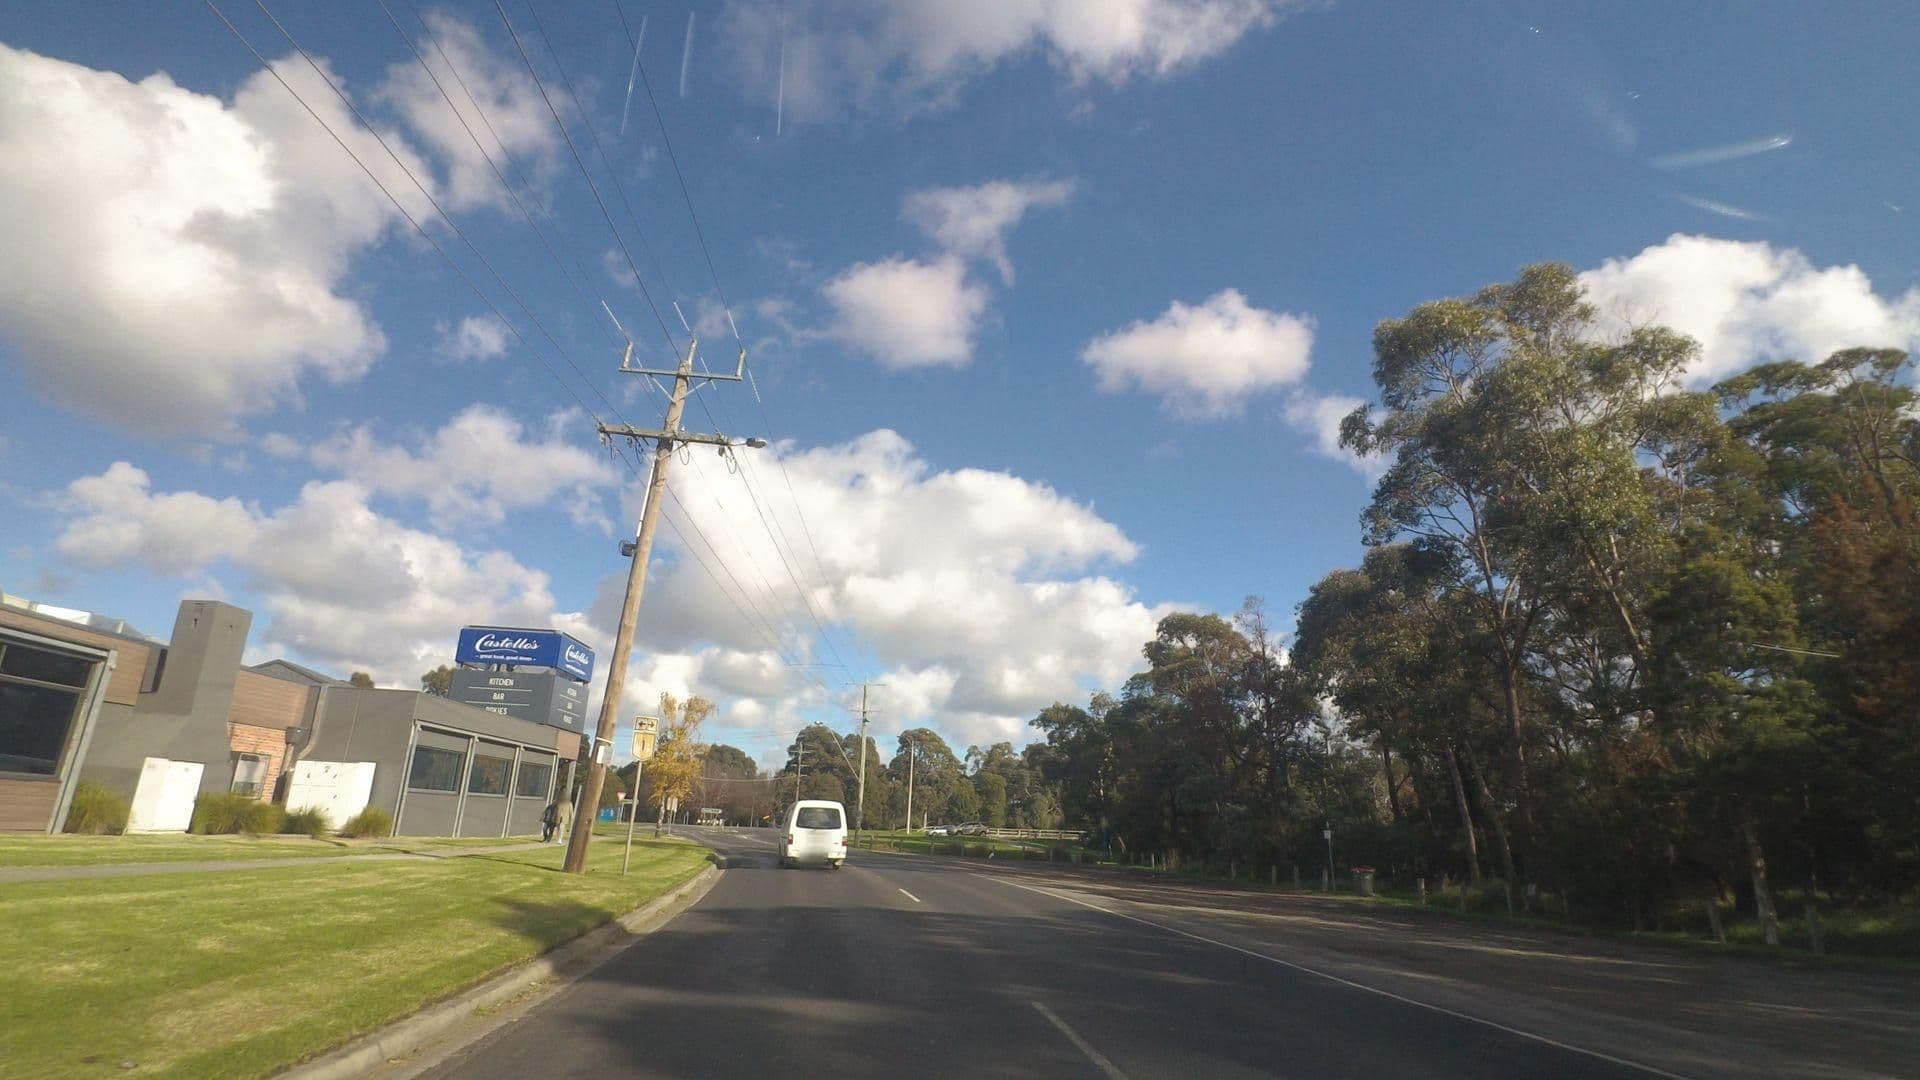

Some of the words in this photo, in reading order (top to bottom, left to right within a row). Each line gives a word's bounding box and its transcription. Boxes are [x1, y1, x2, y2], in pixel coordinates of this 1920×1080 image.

[475, 634, 539, 652] Castello's
[489, 678, 514, 686] KITCHEN
[492, 692, 505, 700] BAR
